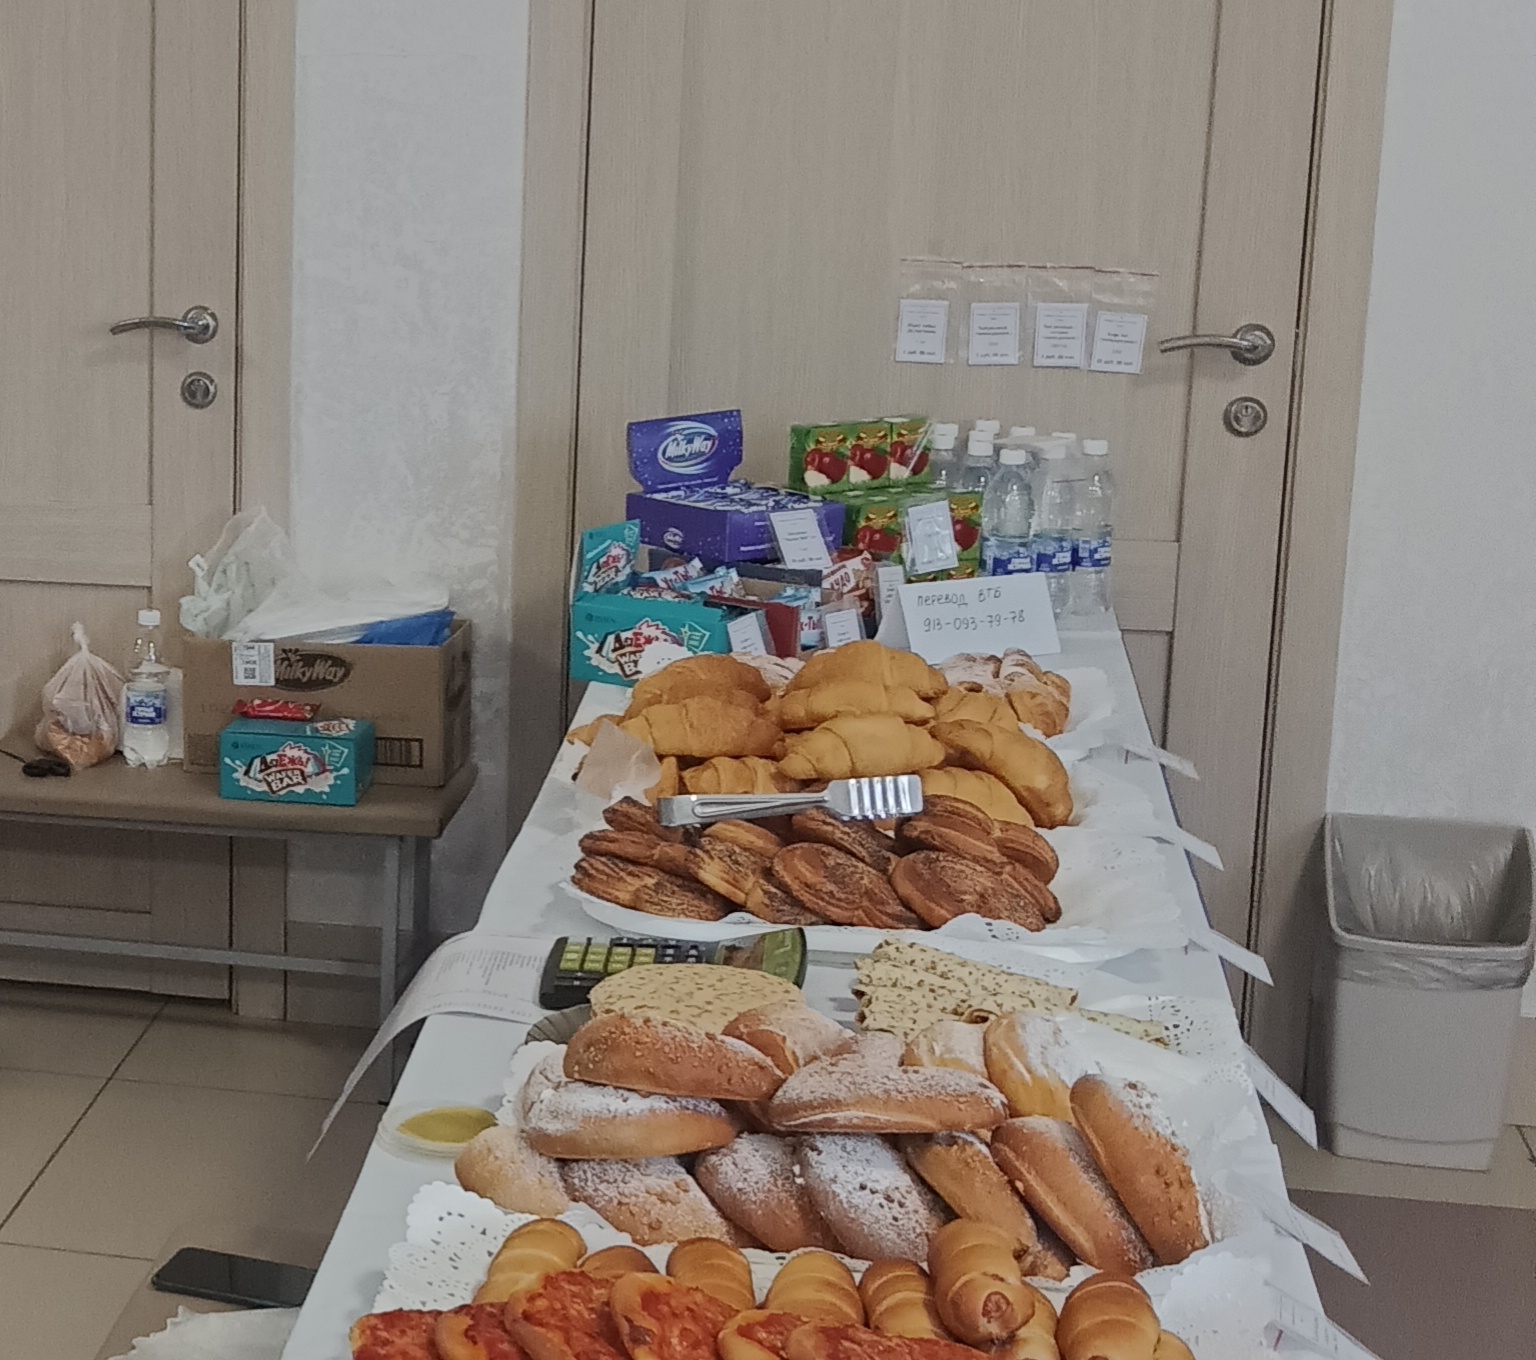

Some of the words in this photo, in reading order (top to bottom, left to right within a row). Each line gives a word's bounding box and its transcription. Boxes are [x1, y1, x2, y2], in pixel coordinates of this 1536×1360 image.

[978, 586, 1002, 603] ВТБ
[923, 609, 1026, 632] 913-093-79-78
[271, 774, 305, 791] BAR
